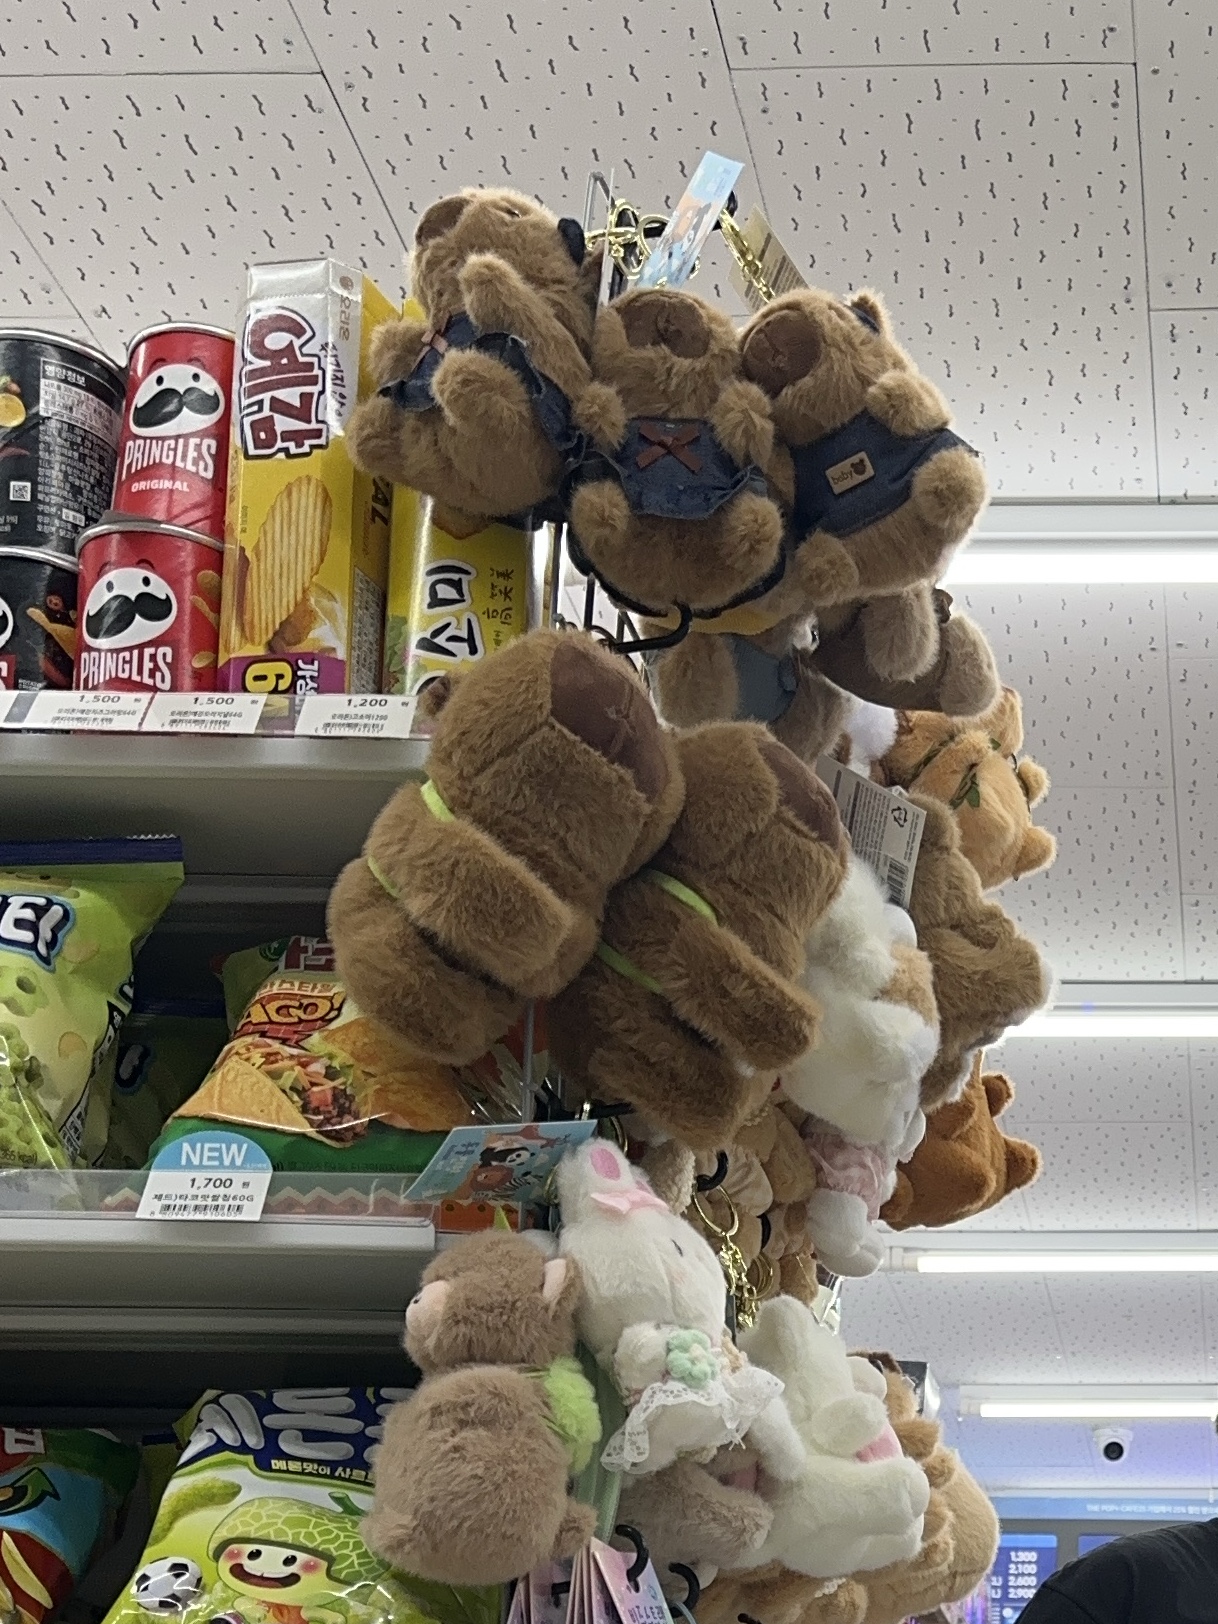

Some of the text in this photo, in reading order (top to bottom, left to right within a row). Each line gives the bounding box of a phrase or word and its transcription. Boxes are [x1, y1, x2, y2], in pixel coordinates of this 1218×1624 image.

[43, 364, 86, 388] 영양정보
[244, 306, 327, 457] 예감
[121, 437, 217, 481] PRINGLES
[131, 479, 190, 493] ORIGINAL
[831, 471, 854, 486] baby
[79, 647, 172, 692] PRINGLES
[193, 696, 234, 706] 1,500
[347, 698, 387, 708] 1,200
[248, 990, 348, 1025] ACO!
[181, 1142, 248, 1166] NEW
[189, 1177, 233, 1191] 1,700
[270, 1459, 331, 1476] 메론맛이
